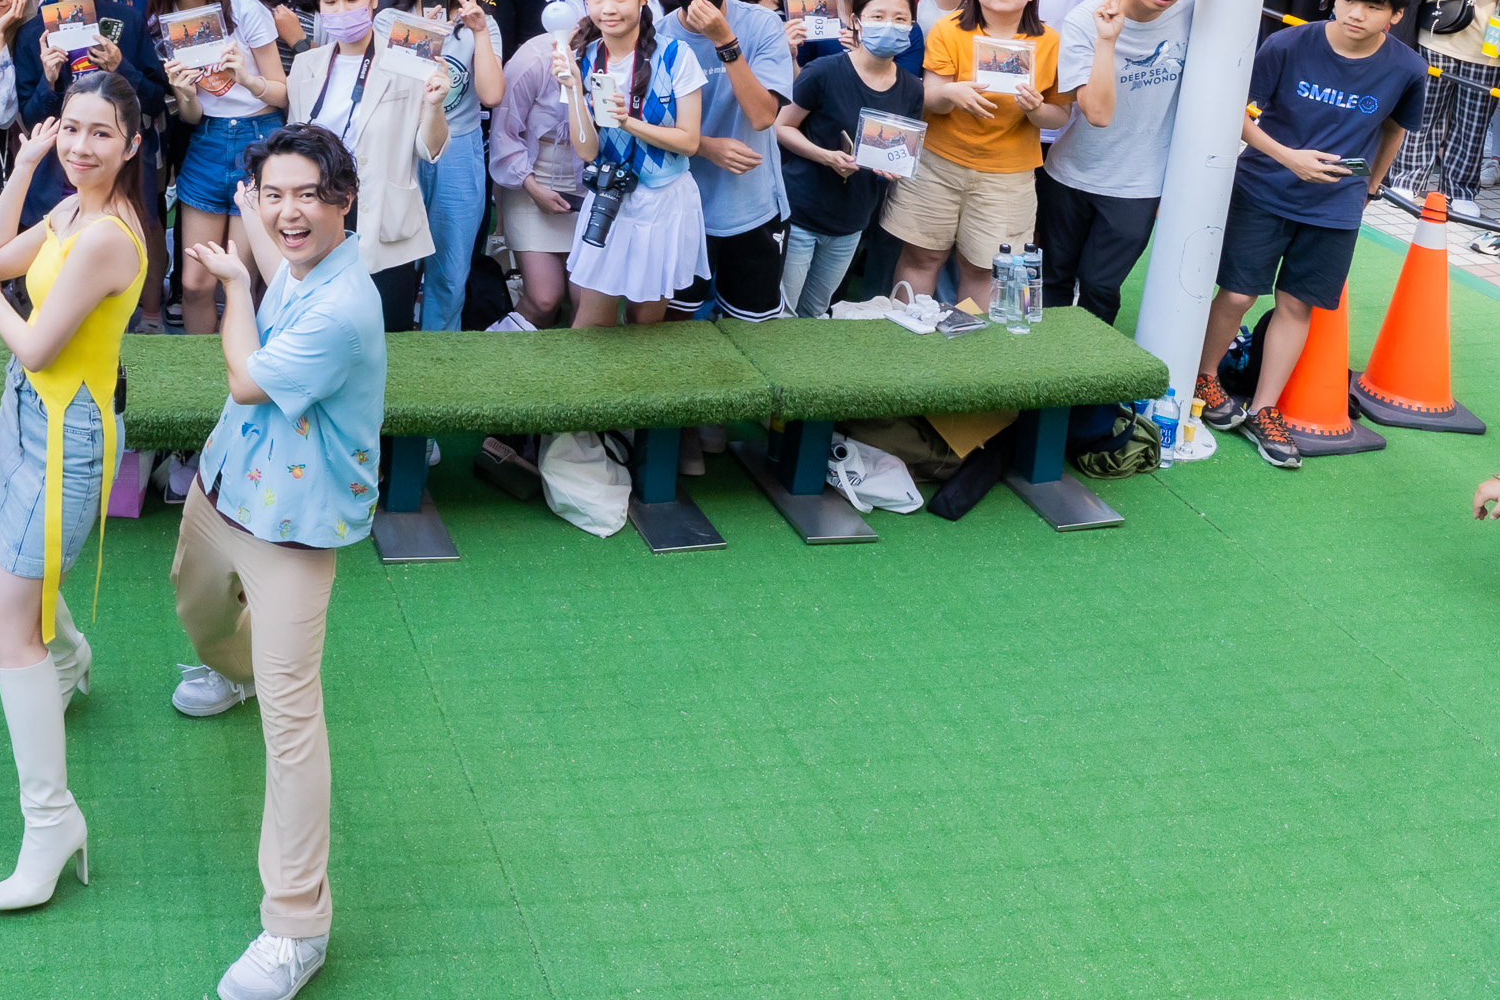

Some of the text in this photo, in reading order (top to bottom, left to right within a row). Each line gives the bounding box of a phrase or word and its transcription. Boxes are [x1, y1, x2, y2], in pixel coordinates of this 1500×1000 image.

[814, 18, 824, 36] 035
[1120, 67, 1169, 84] DEEP SEA
[1143, 73, 1181, 87] WOND
[1296, 80, 1360, 110] SMILE
[887, 148, 908, 162] 033
